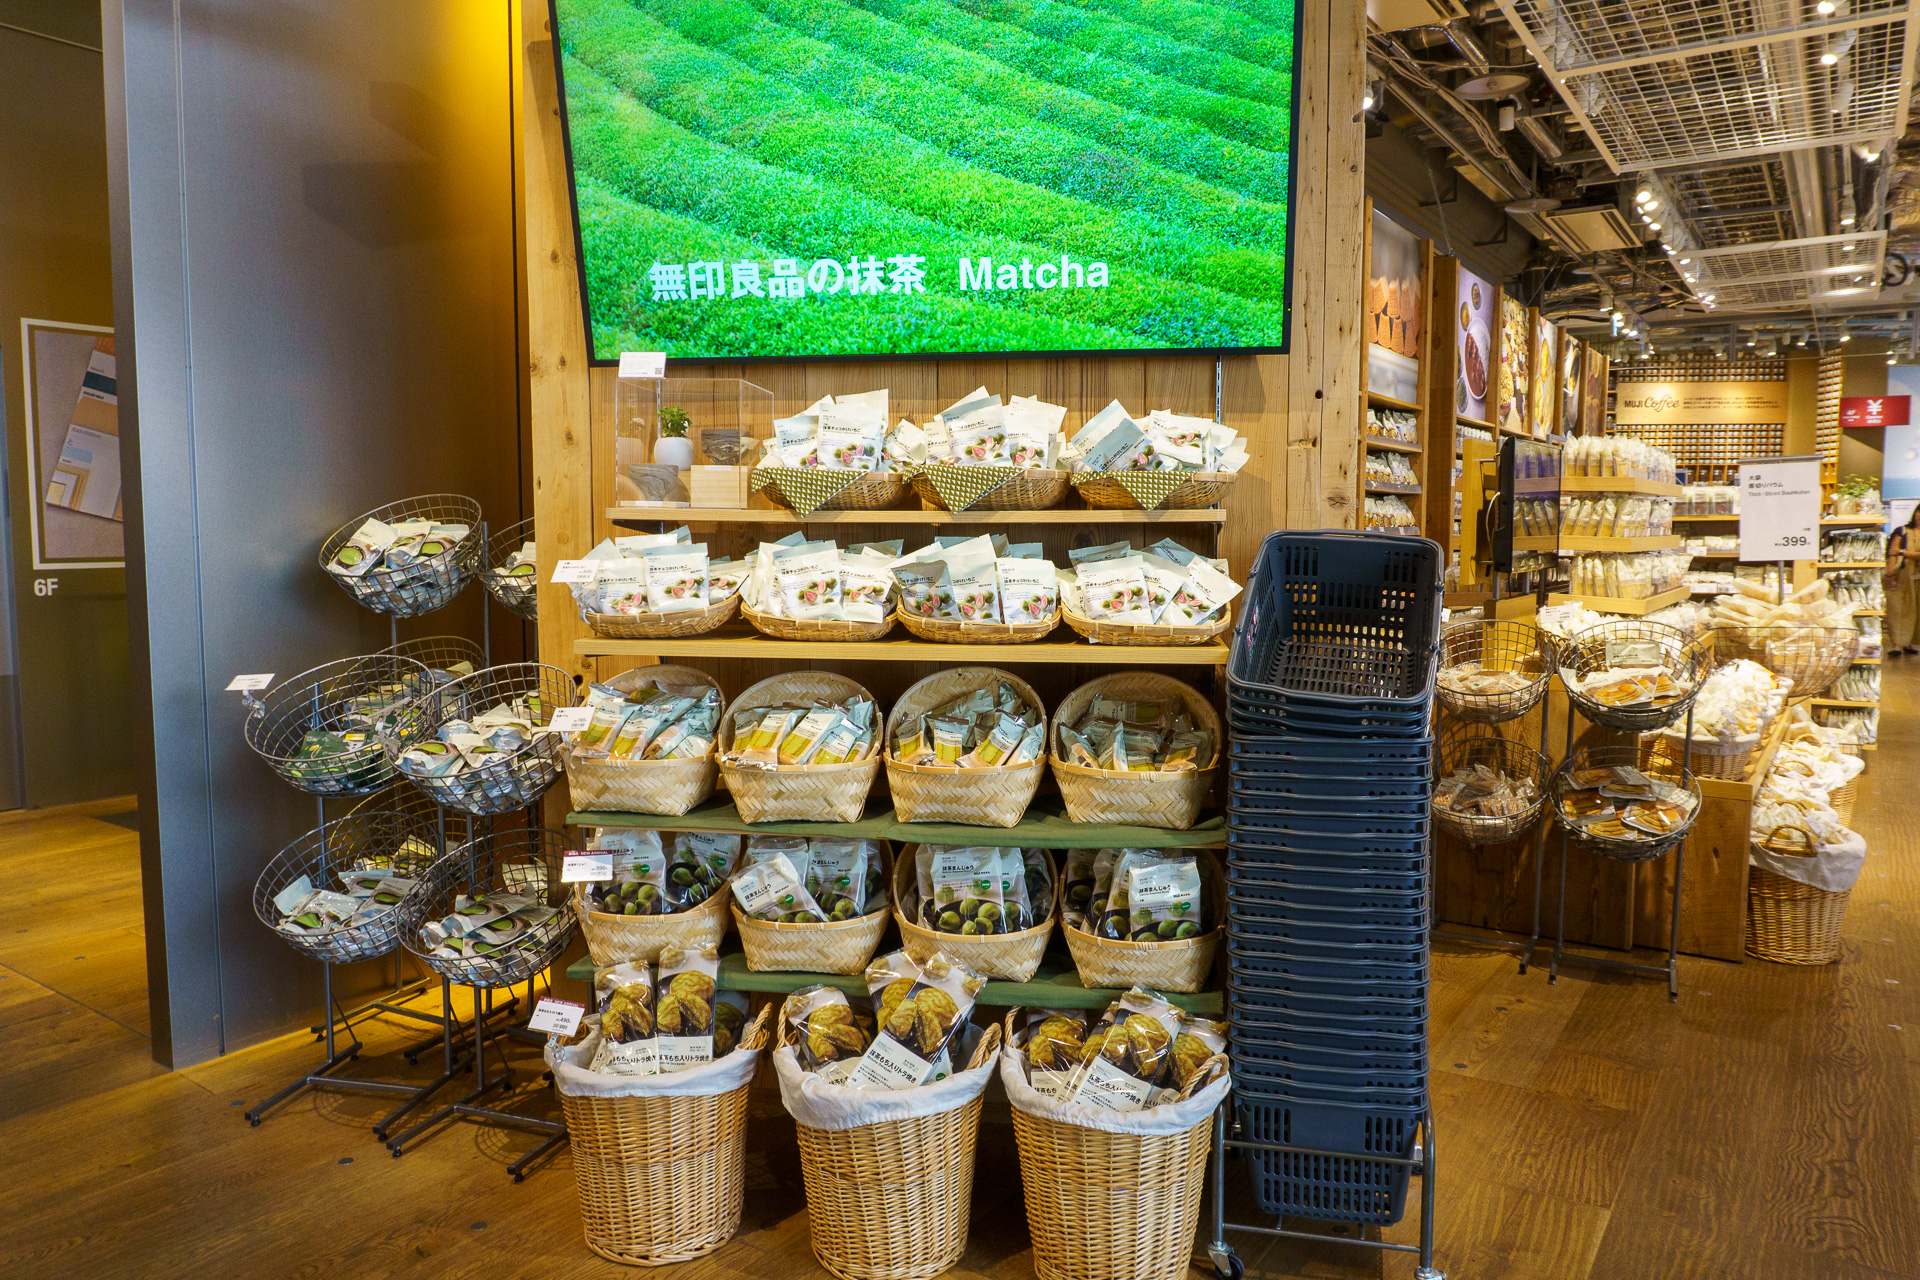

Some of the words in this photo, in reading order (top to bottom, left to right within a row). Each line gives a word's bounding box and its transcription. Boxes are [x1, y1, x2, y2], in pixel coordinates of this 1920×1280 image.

[649, 253, 926, 302] 無印良品の抹茶
[959, 254, 1110, 291] Matcha
[1624, 400, 1643, 408] MUJI
[1644, 394, 1680, 412] Coffee
[1782, 536, 1807, 546] 399
[34, 578, 59, 597] 6F
[869, 1049, 917, 1084] 抹茶もち入りトラ焼き
